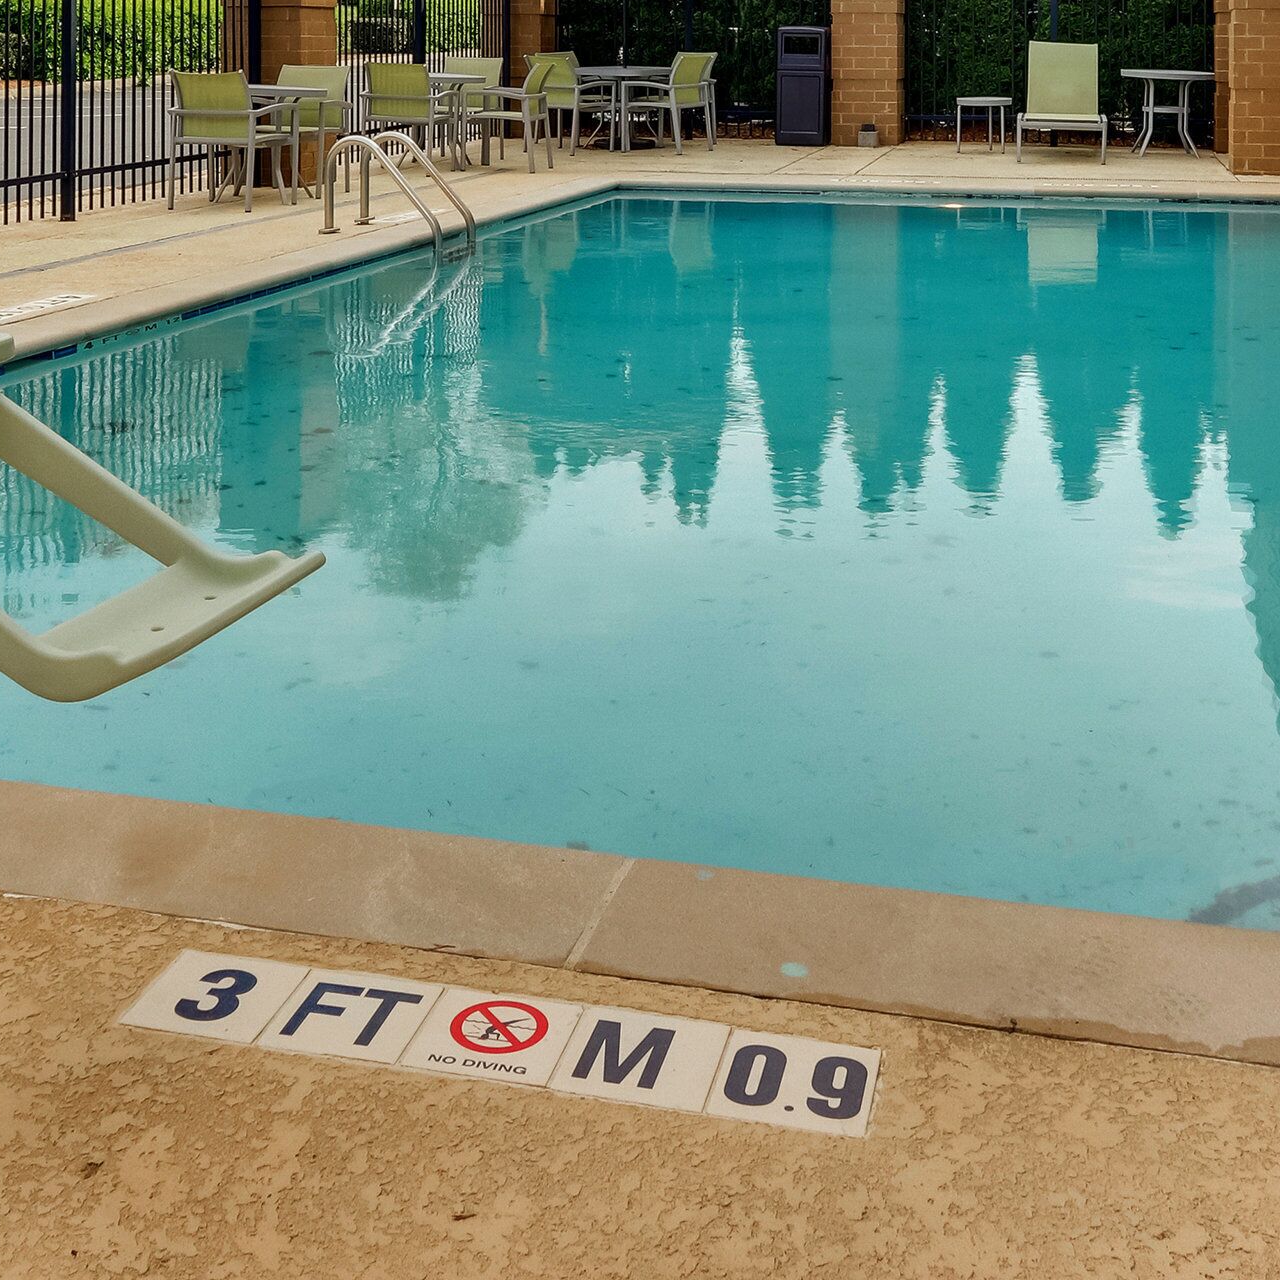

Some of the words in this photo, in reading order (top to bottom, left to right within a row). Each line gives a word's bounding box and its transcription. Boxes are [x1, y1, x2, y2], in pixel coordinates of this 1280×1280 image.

[174, 969, 258, 1022] 3
[279, 983, 424, 1047] FT
[571, 1020, 677, 1090] M
[722, 1045, 869, 1120] 0.9
[427, 1053, 458, 1067] NO
[461, 1058, 528, 1076] DIVING
